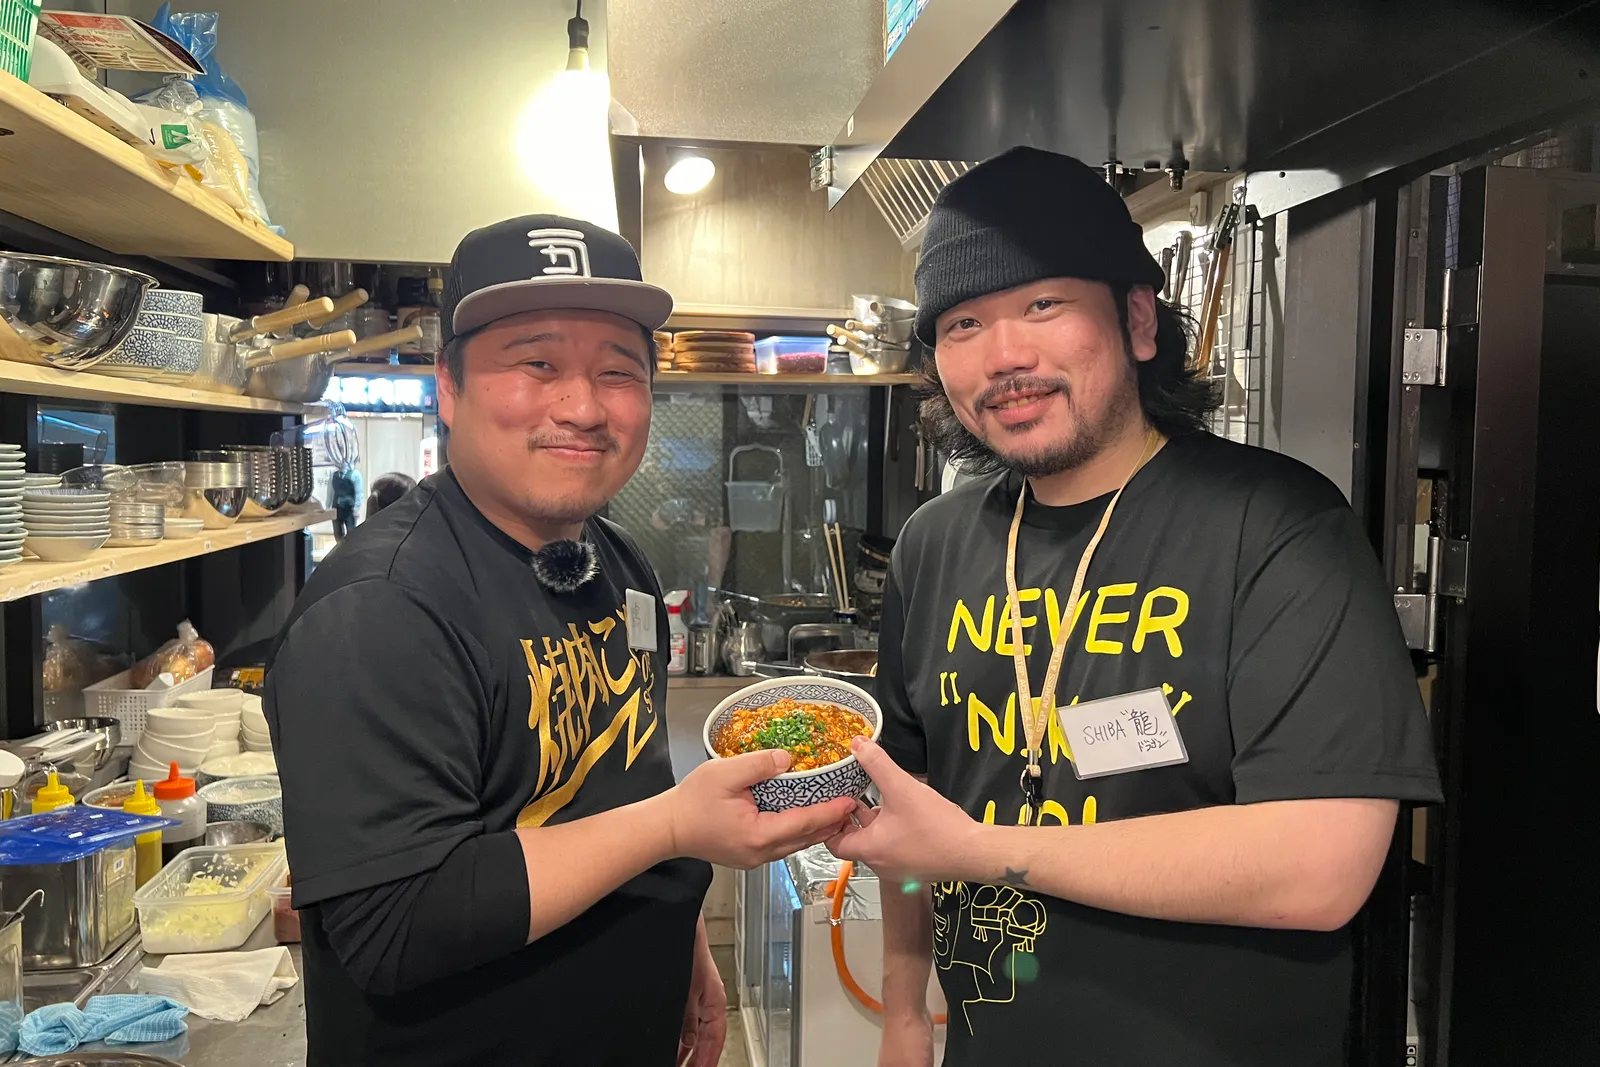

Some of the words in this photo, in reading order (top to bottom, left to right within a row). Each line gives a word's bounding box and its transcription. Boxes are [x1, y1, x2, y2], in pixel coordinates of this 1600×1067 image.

[947, 582, 1190, 658] NEVER
[1036, 711, 1046, 732] STEP
[1041, 673, 1056, 709] ACROSS
[1053, 644, 1065, 662] LINE
[1083, 719, 1127, 745] SHIBA
